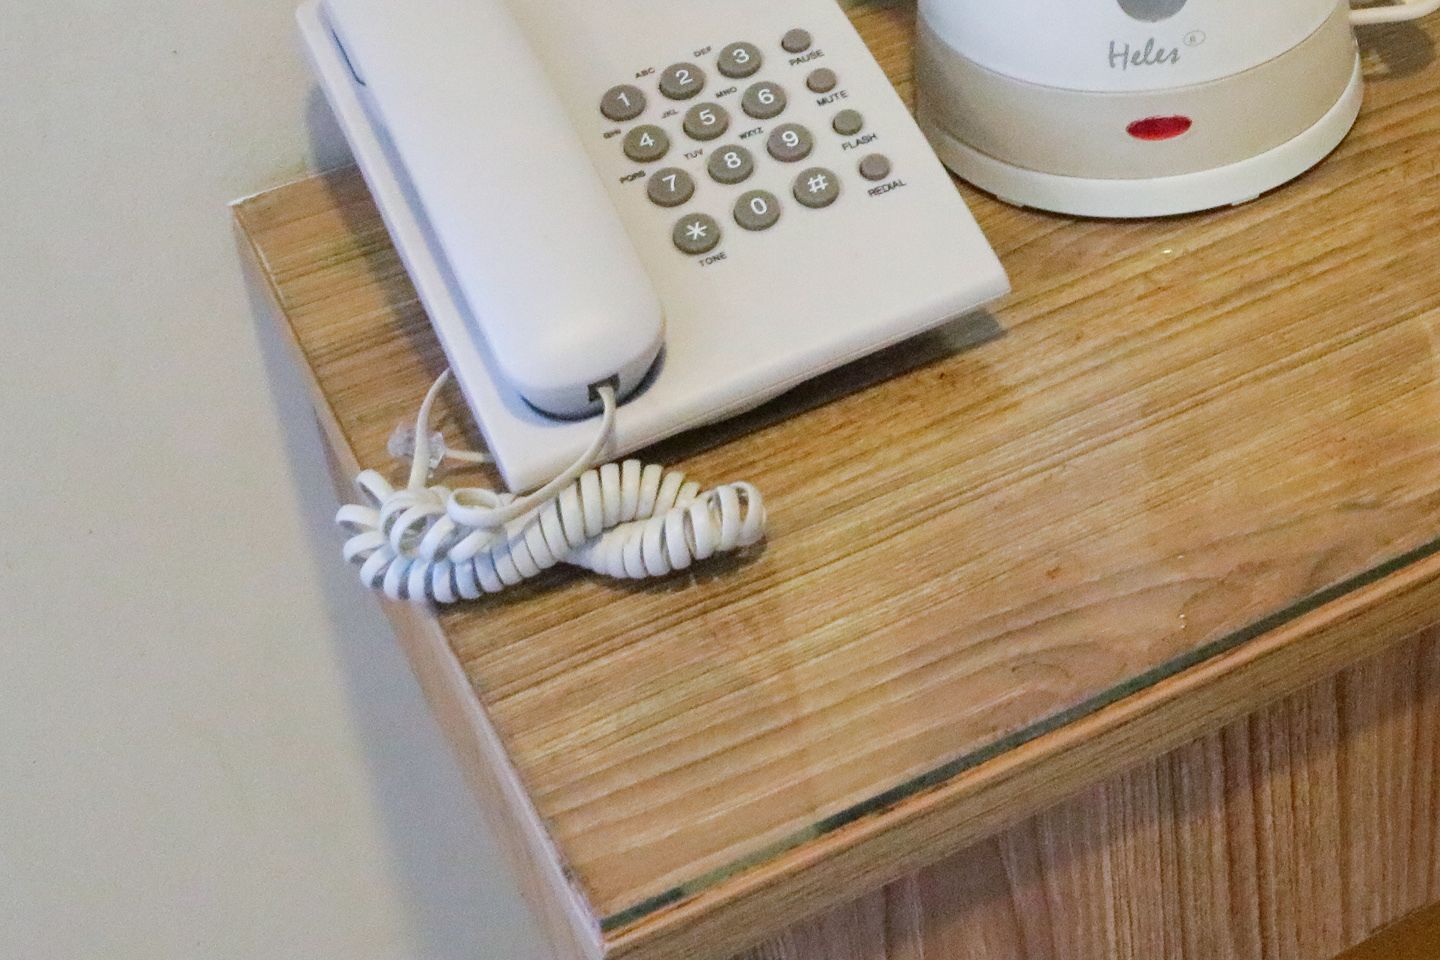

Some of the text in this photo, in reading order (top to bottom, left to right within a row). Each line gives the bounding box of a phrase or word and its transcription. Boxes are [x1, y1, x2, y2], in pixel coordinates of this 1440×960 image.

[732, 48, 750, 63] 3
[788, 49, 825, 67] PAUSE
[635, 67, 656, 78] ABC
[675, 69, 693, 86] 2
[617, 92, 631, 107] 1
[758, 88, 775, 104] 6
[816, 90, 848, 107] MUTE
[699, 109, 716, 125] 5
[640, 132, 655, 147] 4
[782, 130, 799, 147] 9
[842, 133, 877, 152] FLASH
[724, 152, 742, 169] 8
[662, 174, 677, 192] 7
[867, 179, 907, 198] REDIAL
[698, 251, 728, 268] TONE
